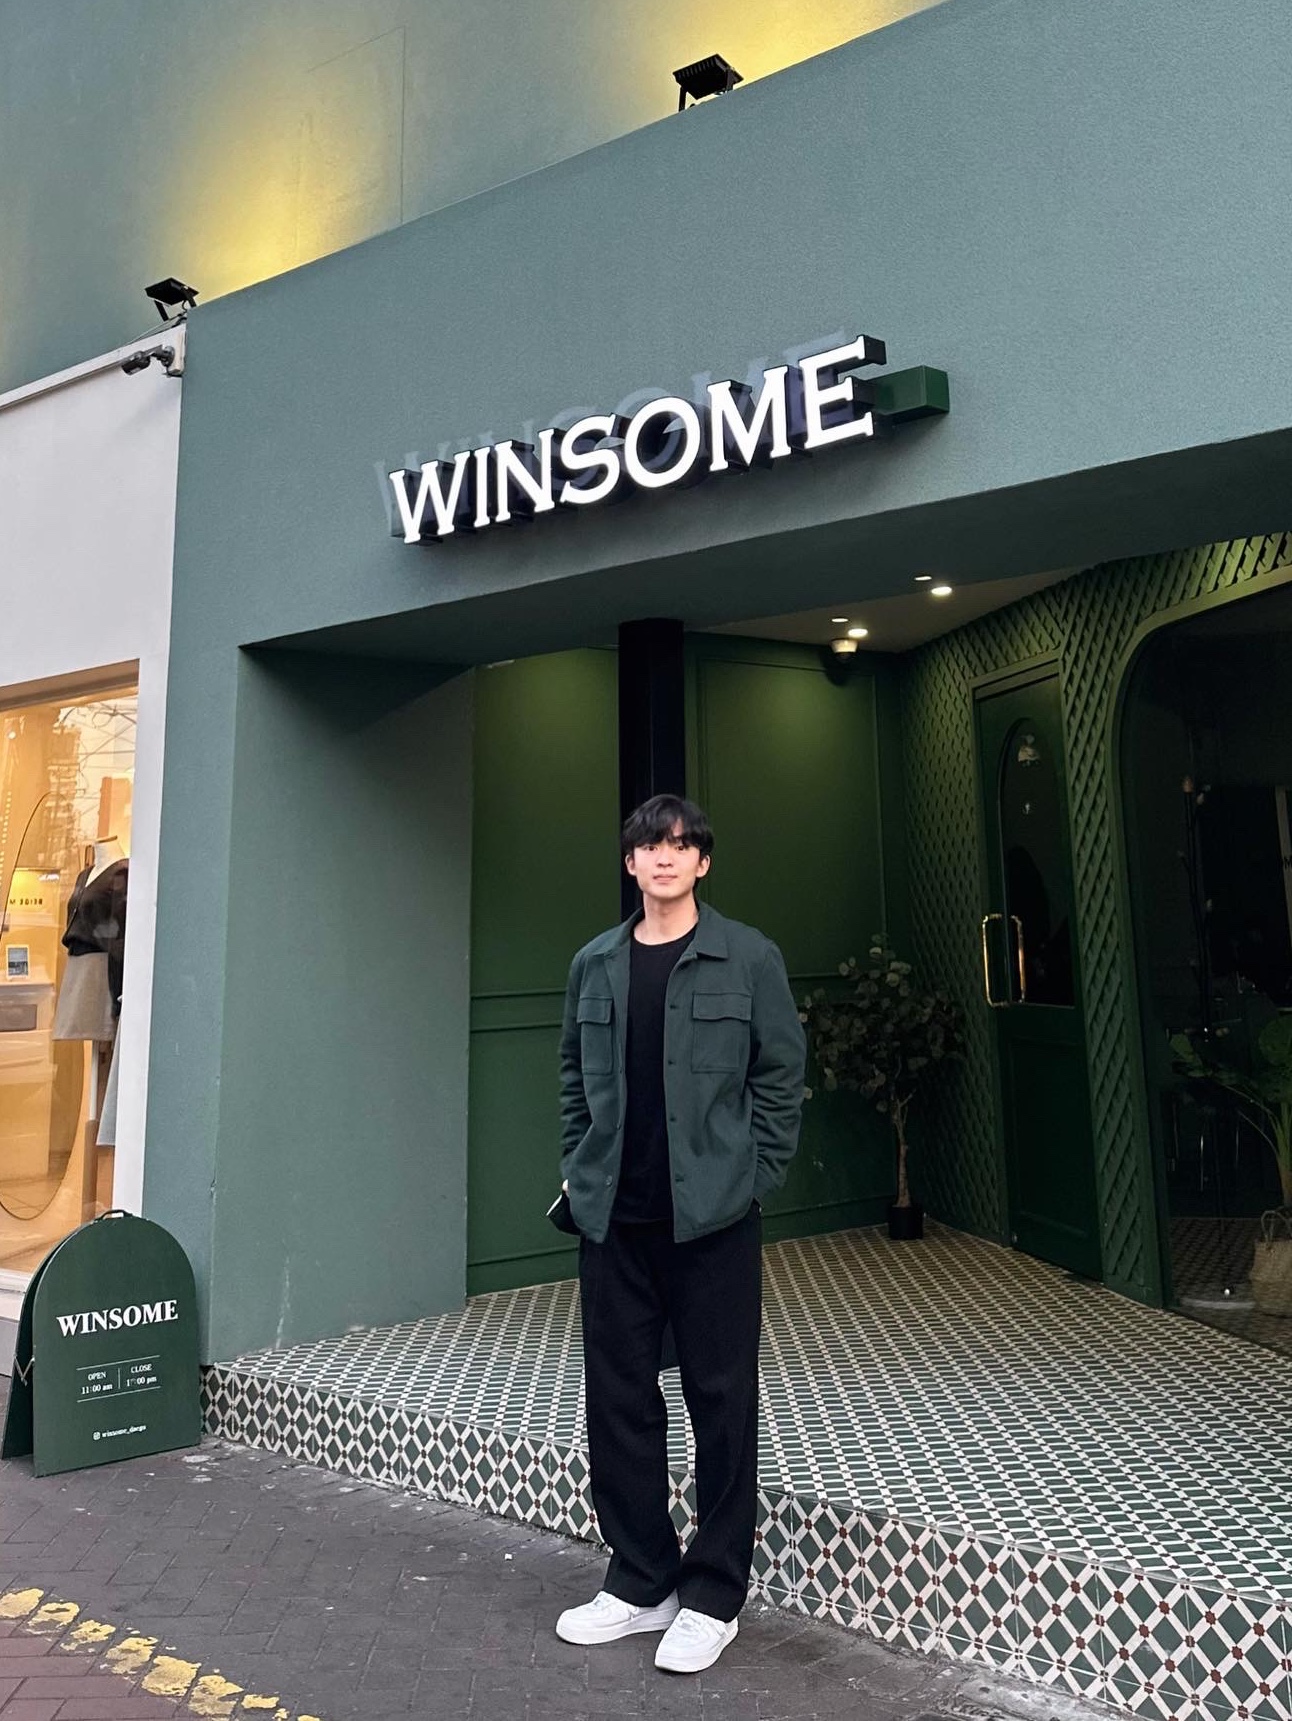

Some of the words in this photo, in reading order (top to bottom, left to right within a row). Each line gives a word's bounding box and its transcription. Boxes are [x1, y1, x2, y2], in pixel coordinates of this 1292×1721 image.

[389, 335, 874, 544] WINSOME
[56, 1300, 179, 1337] WINSOME
[130, 1363, 153, 1374] CLOSE
[88, 1371, 107, 1381] OPEN
[146, 1376, 158, 1385] pm
[81, 1384, 102, 1395] 11:00
